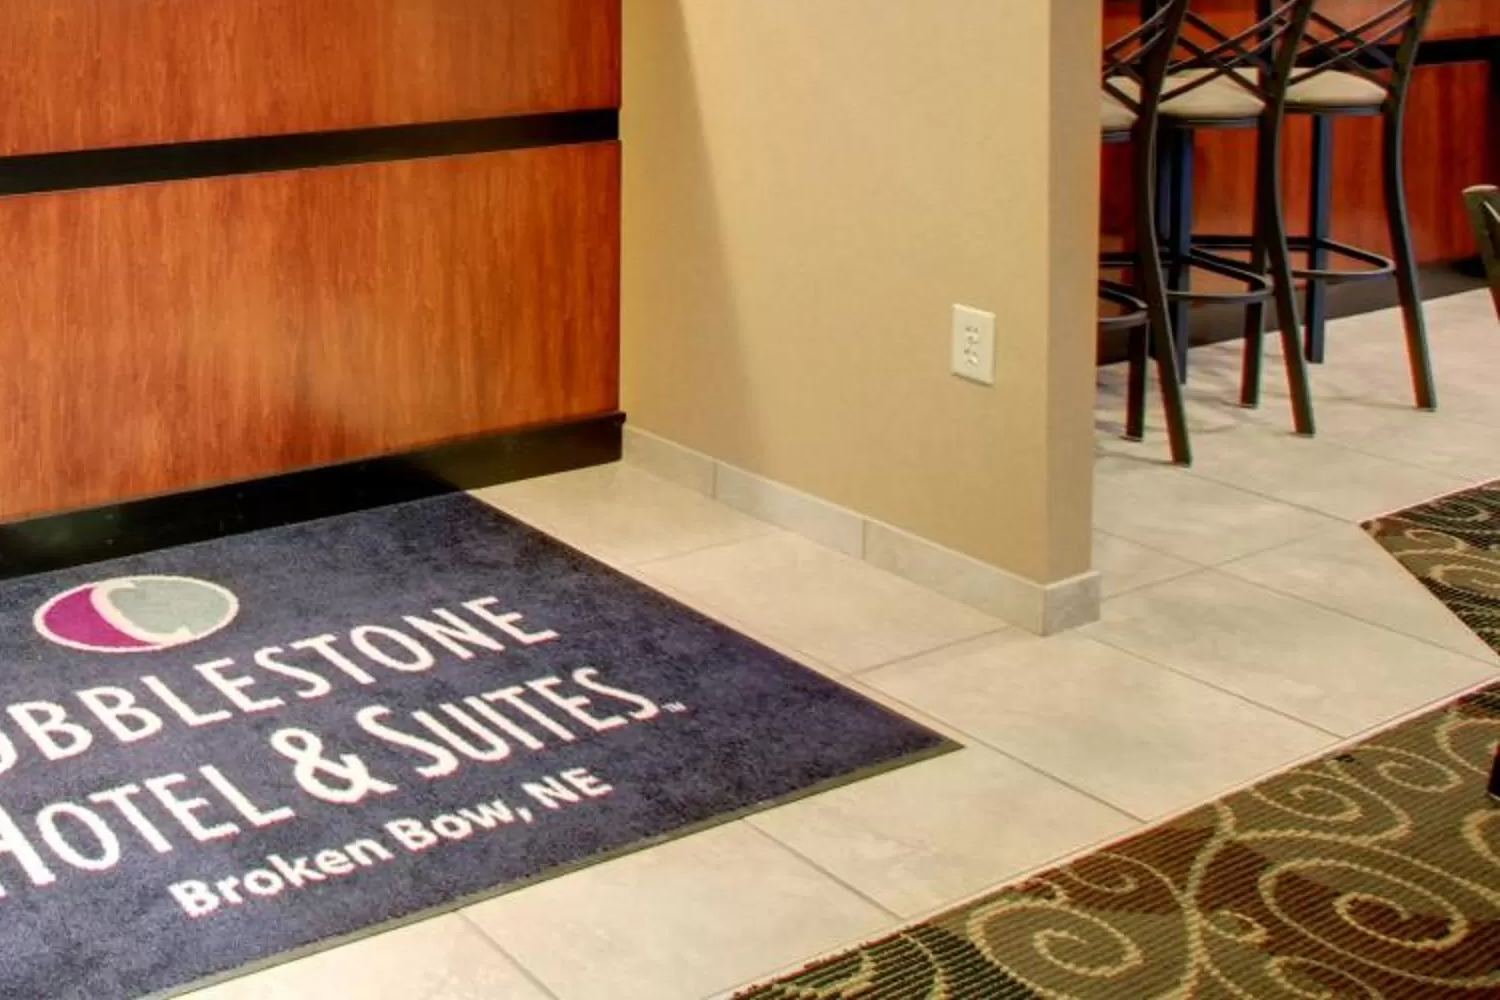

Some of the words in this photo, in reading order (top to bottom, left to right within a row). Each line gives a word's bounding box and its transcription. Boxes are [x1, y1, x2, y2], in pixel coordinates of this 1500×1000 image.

[270, 726, 398, 803] &
[167, 838, 394, 918] Broken
[384, 799, 533, 851] Bow,
[521, 767, 614, 809] NE
